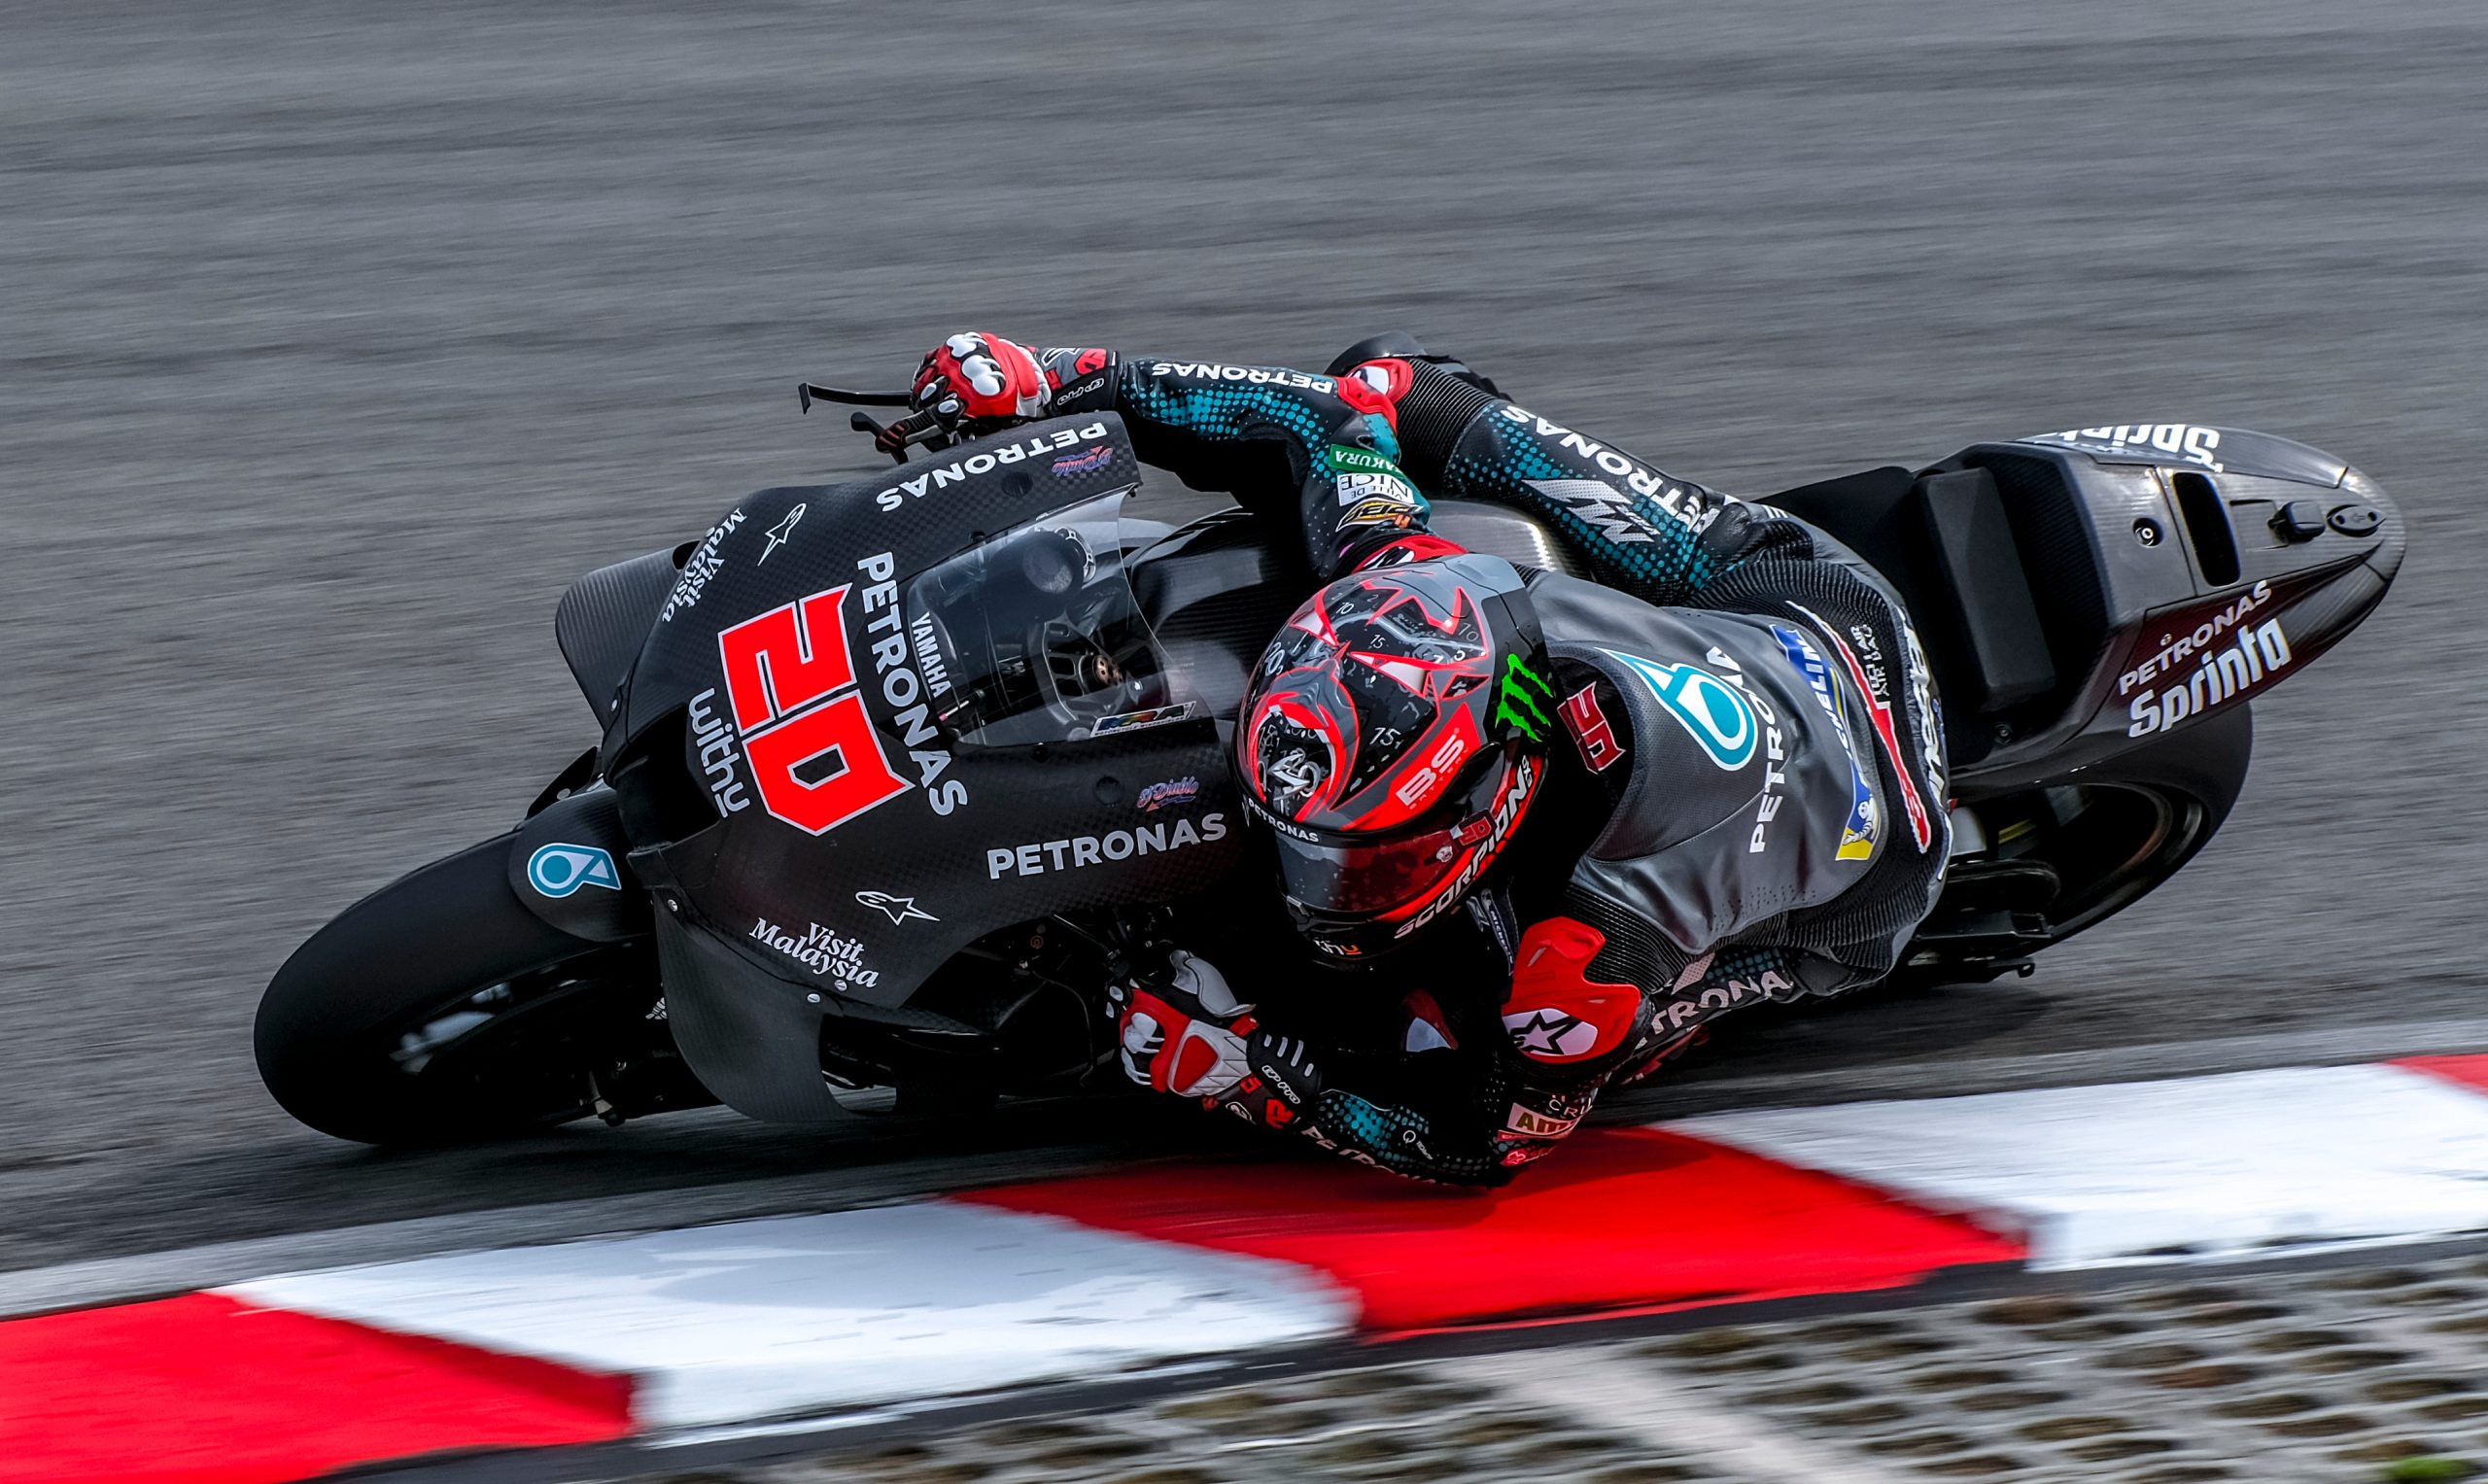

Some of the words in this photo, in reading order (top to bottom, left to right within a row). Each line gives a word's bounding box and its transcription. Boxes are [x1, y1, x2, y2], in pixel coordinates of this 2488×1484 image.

[1152, 362, 1334, 395] PETRONAS
[876, 422, 1108, 512] PETRONAS
[1339, 474, 1408, 498] NICE
[662, 507, 747, 623] Malaysia
[682, 557, 725, 608] Visit
[909, 611, 951, 699] YAMAHA
[2119, 579, 2272, 696] PETRONAS
[2128, 617, 2293, 740] Sprinta
[717, 582, 916, 836] 20
[857, 551, 968, 816] PETRONAS
[688, 687, 750, 818] withu
[1396, 734, 1465, 807] BS
[986, 812, 1227, 880] PETRONAS
[1247, 797, 1320, 843] PETRONAS
[1393, 764, 1529, 941] SCORPION
[748, 917, 880, 988] Malaysia
[806, 921, 865, 964] Visit
